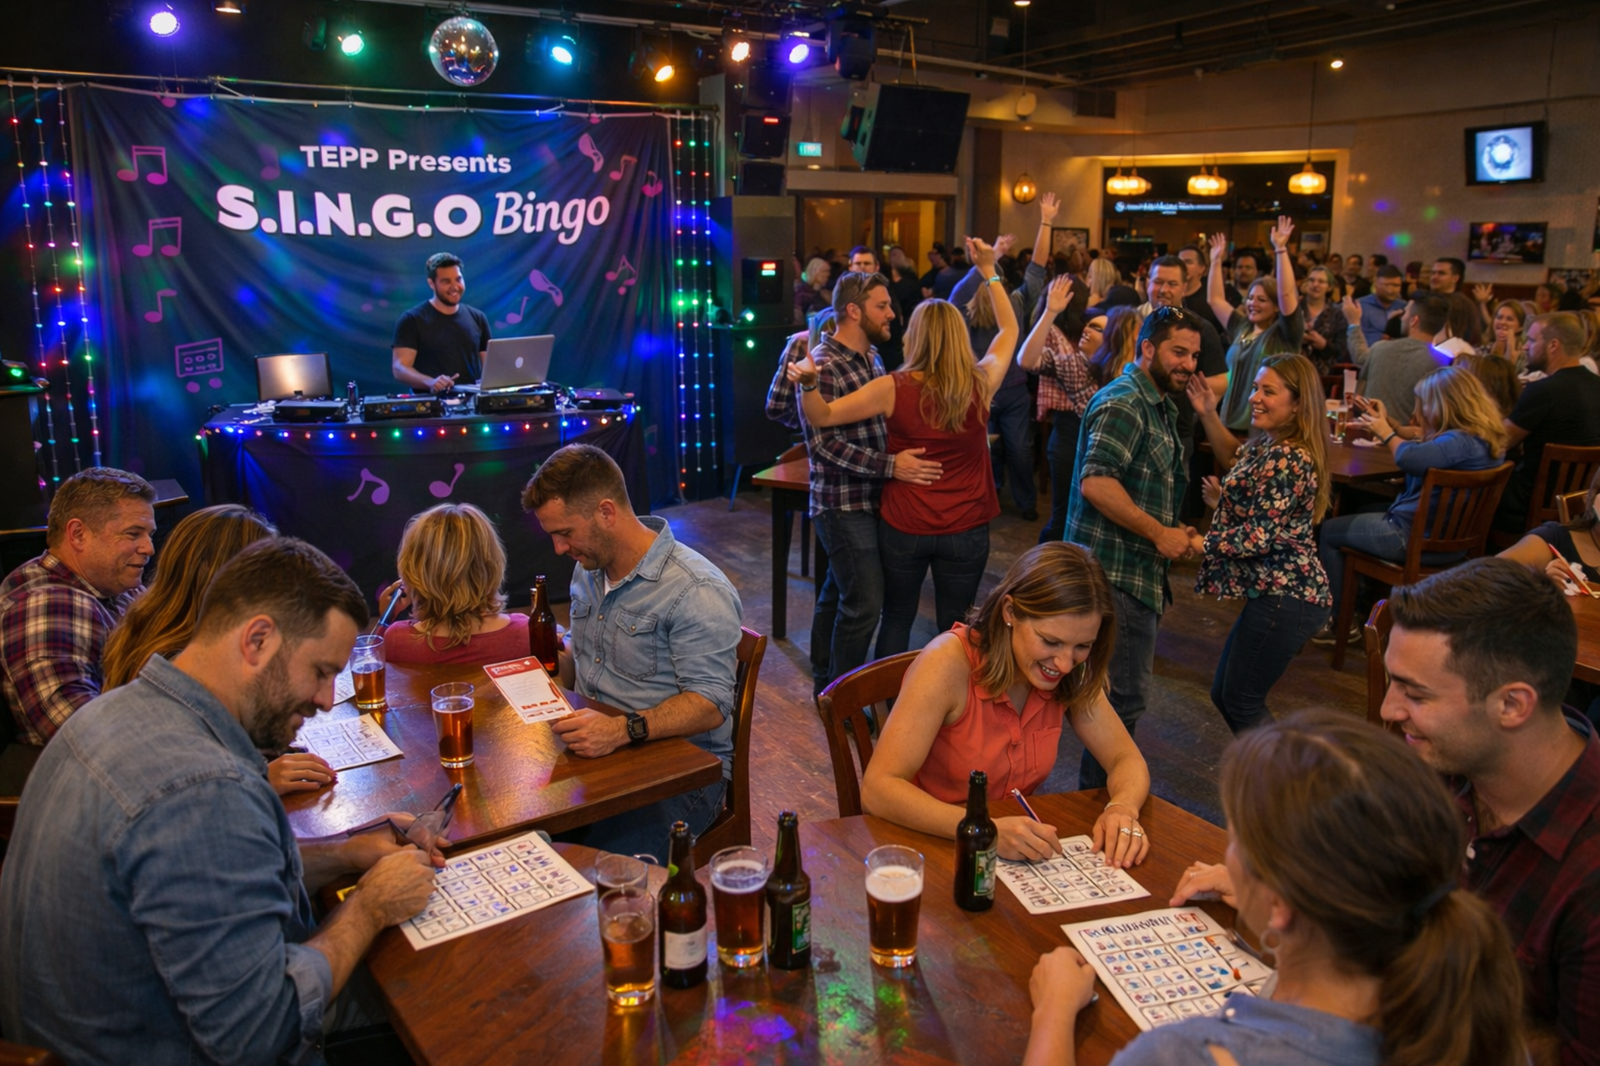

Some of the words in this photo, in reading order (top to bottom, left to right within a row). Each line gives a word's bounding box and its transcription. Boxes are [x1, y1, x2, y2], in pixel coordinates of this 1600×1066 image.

[300, 145, 379, 169] TEPP
[388, 149, 511, 173] Presents
[216, 184, 482, 238] S.I.N.G.O
[493, 191, 610, 245] Bingo
